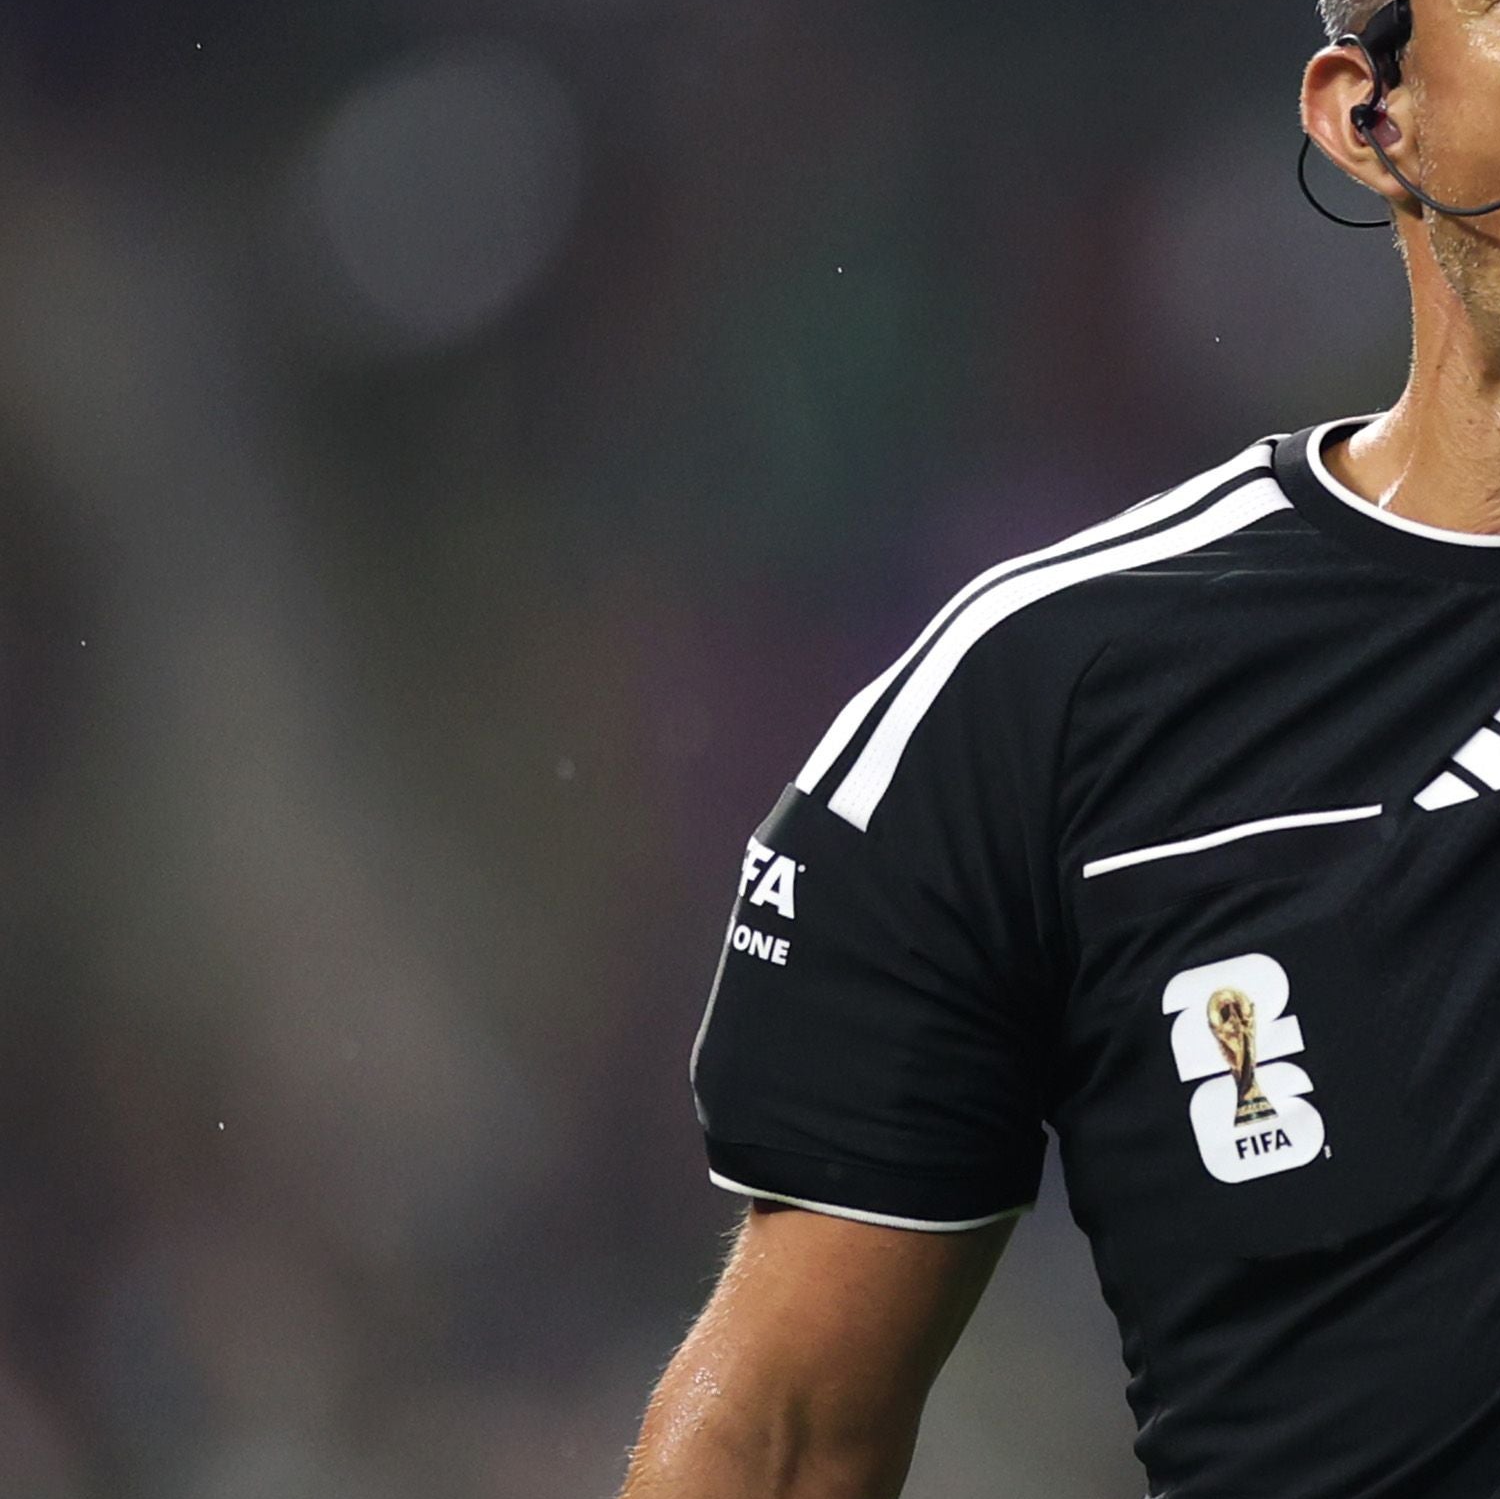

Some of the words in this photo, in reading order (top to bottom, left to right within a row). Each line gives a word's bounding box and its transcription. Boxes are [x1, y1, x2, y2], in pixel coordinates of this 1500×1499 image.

[738, 836, 797, 920] FA
[732, 924, 791, 966] ONE
[1235, 1129, 1292, 1160] FIFA
